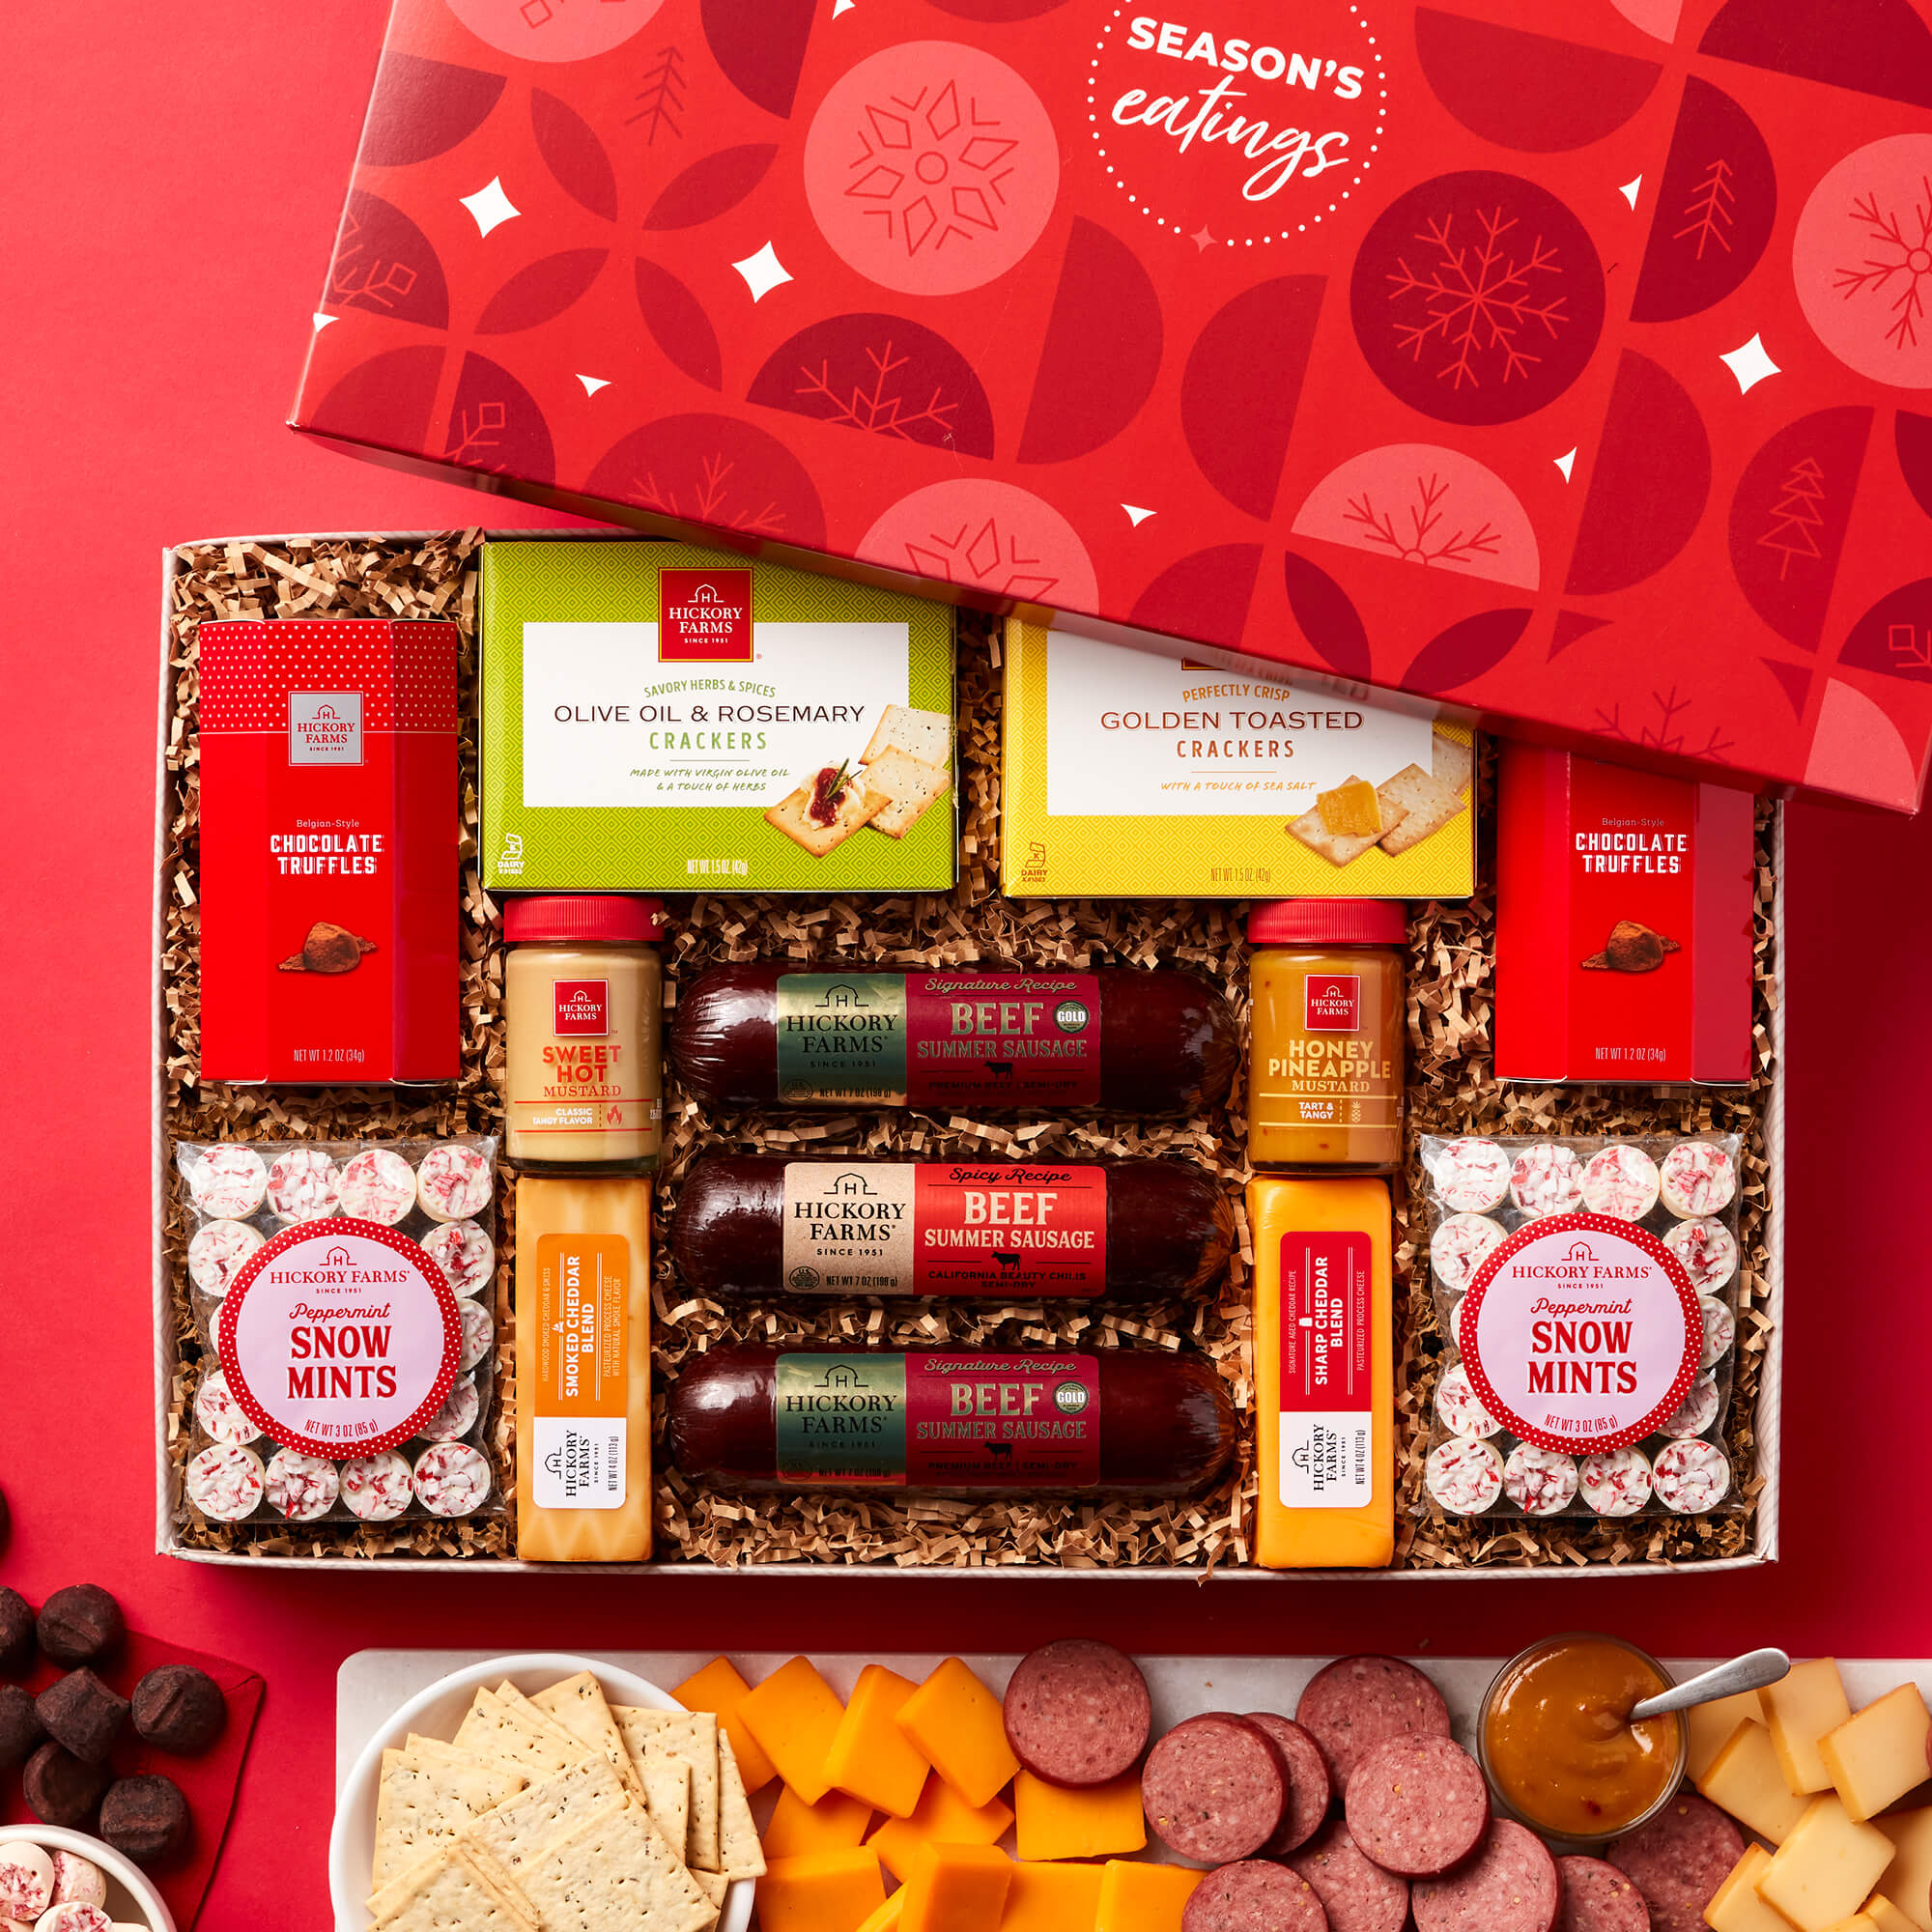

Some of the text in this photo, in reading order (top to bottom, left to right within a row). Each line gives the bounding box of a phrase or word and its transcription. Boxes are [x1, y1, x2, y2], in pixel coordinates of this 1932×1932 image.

[1126, 16, 1364, 99] SEASON'S
[1111, 74, 1350, 201] eatings
[668, 607, 743, 619] HICKORY
[679, 621, 733, 634] FARMS
[644, 679, 776, 697] SAVORY HERBS & SPICES
[1182, 683, 1291, 703] PERFECTLY CRISP
[554, 705, 866, 723] OLIVE OIL & ROSEMARY
[1100, 712, 1363, 729] GOLDEN TOASTED
[297, 723, 355, 732] HICKORY
[305, 734, 348, 744] FARMS
[649, 731, 767, 750] CRACKERS
[1177, 740, 1294, 758] CRACKERS
[629, 768, 789, 780] MADE WITH VIRGIN OLIVE OIL
[667, 781, 674, 791] A
[677, 781, 713, 791] TOUCH
[715, 781, 729, 791] OF
[732, 781, 766, 791] HERBS
[1161, 781, 1317, 791] WITH A TOUCH OF SEA SALT
[297, 819, 359, 829] Belgian-Style
[1602, 818, 1664, 827] Belgian-Style
[270, 835, 384, 853] CHOCOLATE
[1576, 833, 1689, 851] CHOCOLATE
[277, 856, 377, 875] TRUFFLES
[1582, 855, 1681, 873] TRUFFLES
[924, 978, 1077, 994] Signature Recipe
[558, 1004, 603, 1012] HICKORY
[1058, 1010, 1086, 1022] GOLD
[786, 1014, 897, 1032] HICKORY
[951, 1003, 1043, 1036] BEEF
[803, 1036, 883, 1053] FARMS
[918, 1039, 1087, 1059] SUMMER SAUSAGE
[1289, 1039, 1374, 1059] HONEY
[294, 1049, 364, 1063] NET WT 1.2 OZ (34g)
[542, 1045, 621, 1064] SWEET
[556, 1065, 608, 1083] HOT
[1268, 1059, 1391, 1078] PINEAPPLE
[543, 1086, 622, 1097] MUSTARD
[1292, 1080, 1370, 1092] MUSTARD
[950, 1167, 1072, 1184] Spicy Recipe
[794, 1202, 906, 1220] HICKORY
[964, 1191, 1058, 1225] BEEF
[810, 1223, 892, 1241] FARMS
[924, 1229, 1094, 1249] SUMMER SAUSAGE
[859, 1248, 883, 1257] 1951
[270, 1270, 407, 1284] HICKORY FARMS
[928, 1270, 996, 1281] CALIFORNIA
[1000, 1270, 1045, 1281] BEAUTY
[1512, 1265, 1649, 1279] HICKORY FARMS
[604, 1275, 612, 1301] CHEESE
[981, 1281, 1036, 1290] SEMI-DRY
[289, 1302, 391, 1323] Peppermint
[1530, 1297, 1632, 1319] Peppermint
[566, 1256, 580, 1397] SMOKED CHEDDAR
[582, 1303, 594, 1352] BLEND
[1315, 1257, 1328, 1385] SHARP CHEDDAR
[1330, 1298, 1343, 1348] BLEND
[1356, 1270, 1365, 1371] PASTEURIZED PROCESS CHEESE
[291, 1325, 392, 1360] SNOW
[1532, 1321, 1634, 1354] SNOW
[924, 1358, 1077, 1375] Signature Recipe
[287, 1365, 397, 1399] MINTS
[1527, 1361, 1637, 1394] MINTS
[786, 1395, 896, 1412] HICKORY
[950, 1383, 1043, 1416] BEEF
[1057, 1391, 1085, 1404] GOLD
[304, 1418, 320, 1435] NET
[322, 1424, 334, 1437] WT
[335, 1426, 341, 1437] 3
[343, 1425, 354, 1436] OZ
[802, 1416, 882, 1435] FARMS
[917, 1421, 1087, 1439] SUMMER SAUSAGE
[1313, 1424, 1324, 1492] HICKORY
[1326, 1433, 1337, 1482] FARMS
[1355, 1449, 1365, 1458] OZ
[566, 1431, 578, 1496] HICKORY
[579, 1439, 589, 1488] FARMS
[1355, 1463, 1365, 1472] WT
[1355, 1474, 1365, 1485] NET
